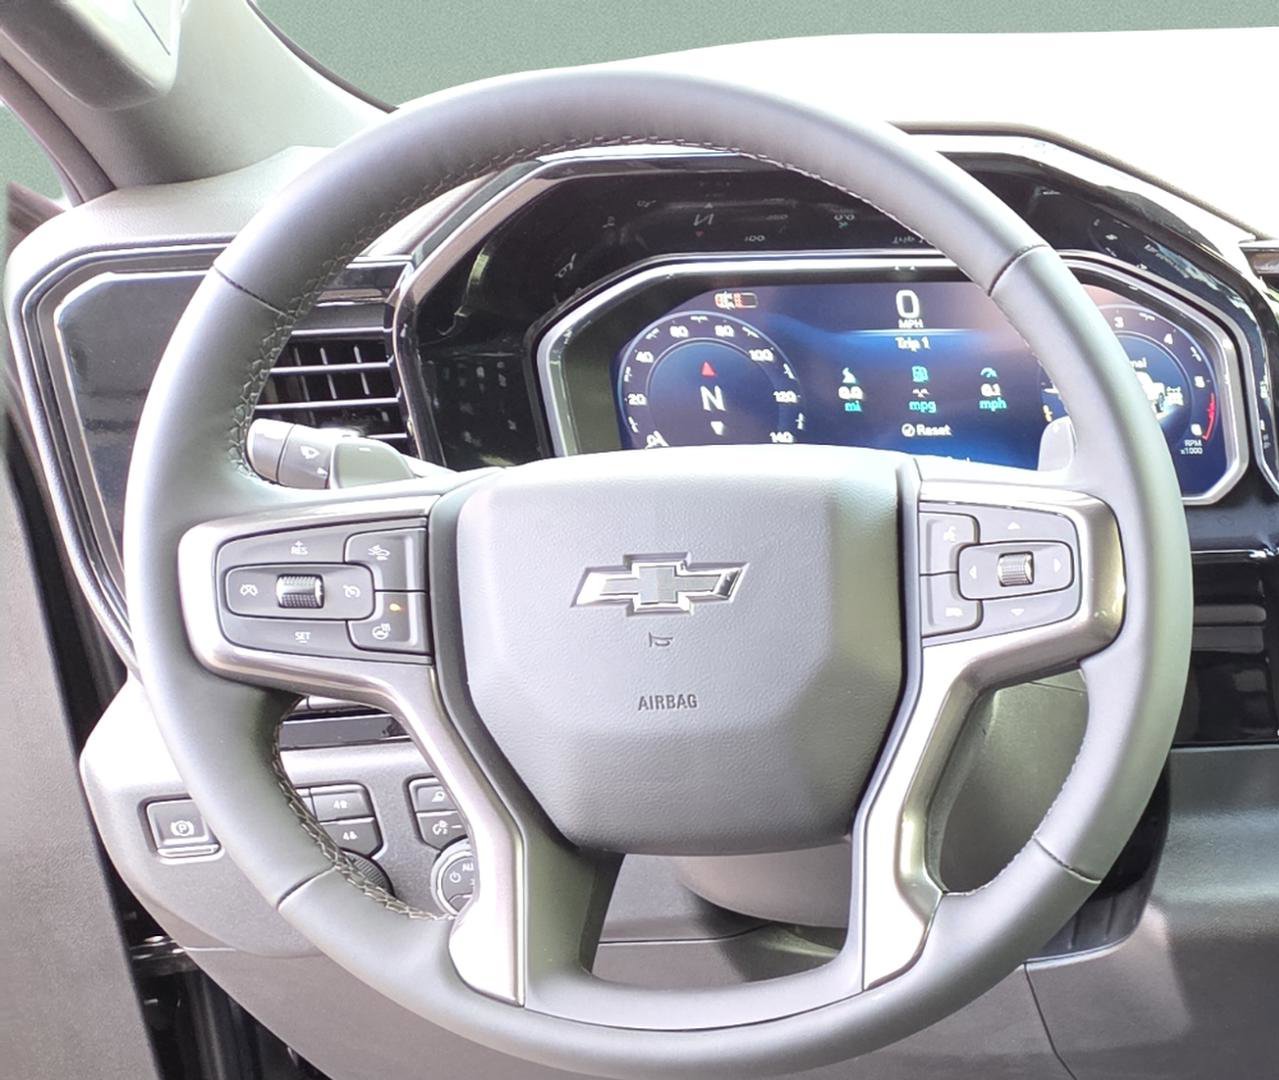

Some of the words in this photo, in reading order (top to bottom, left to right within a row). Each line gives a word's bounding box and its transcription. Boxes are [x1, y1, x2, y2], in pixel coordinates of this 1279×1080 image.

[896, 289, 920, 319] 0
[898, 319, 924, 329] MPH
[1114, 317, 1124, 328] 3
[895, 337, 920, 352] Trip
[921, 337, 930, 349] 1
[1163, 333, 1173, 345] 4
[749, 348, 775, 362] 100
[628, 393, 647, 405] 20
[700, 385, 726, 412] N
[979, 397, 1007, 411] mph
[845, 400, 862, 412] mi
[909, 400, 937, 414] mpg
[916, 424, 952, 437] Reset
[769, 431, 794, 443] 140
[1184, 439, 1203, 447] RPM
[294, 631, 311, 641] SET
[638, 694, 697, 711] AIRBAG
